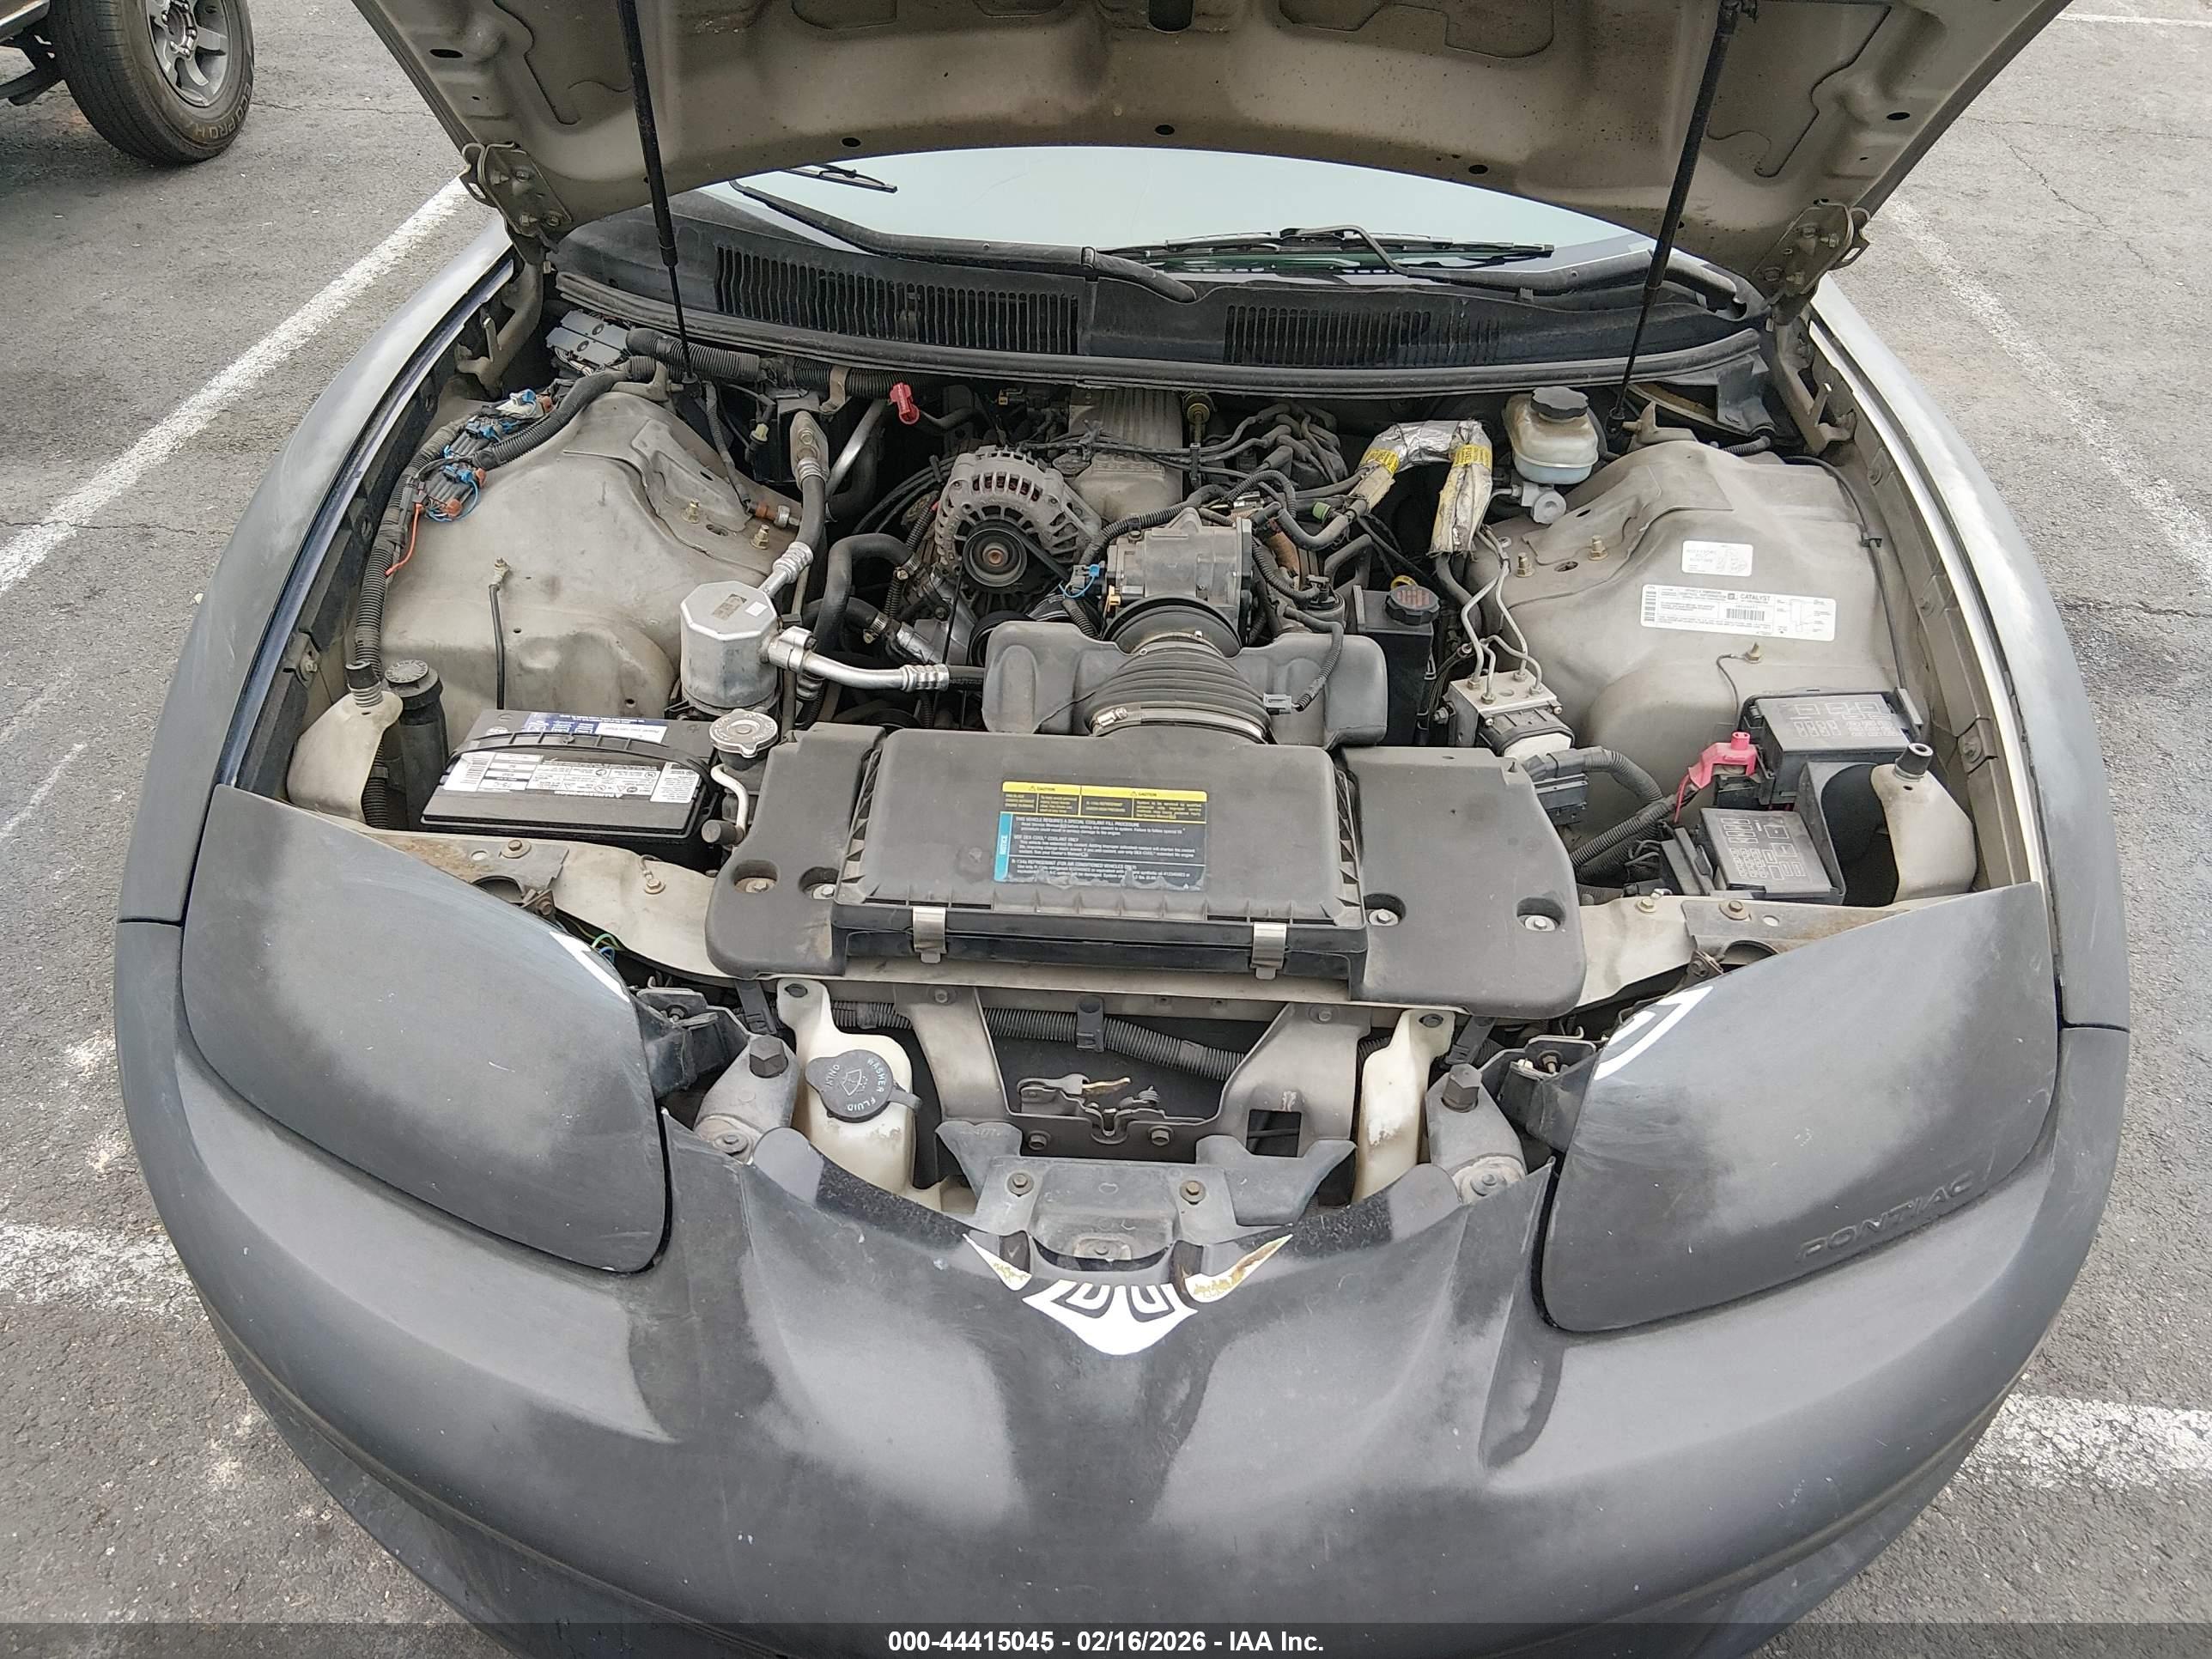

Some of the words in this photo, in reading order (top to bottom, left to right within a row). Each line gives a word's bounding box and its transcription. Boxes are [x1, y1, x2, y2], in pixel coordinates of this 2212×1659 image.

[1740, 593, 1771, 601] CATALYST
[825, 1064, 840, 1087] ONLY
[867, 1057, 887, 1093] WASHER
[847, 1096, 876, 1112] FLUID
[1795, 1170, 1974, 1263] PONTIAC
